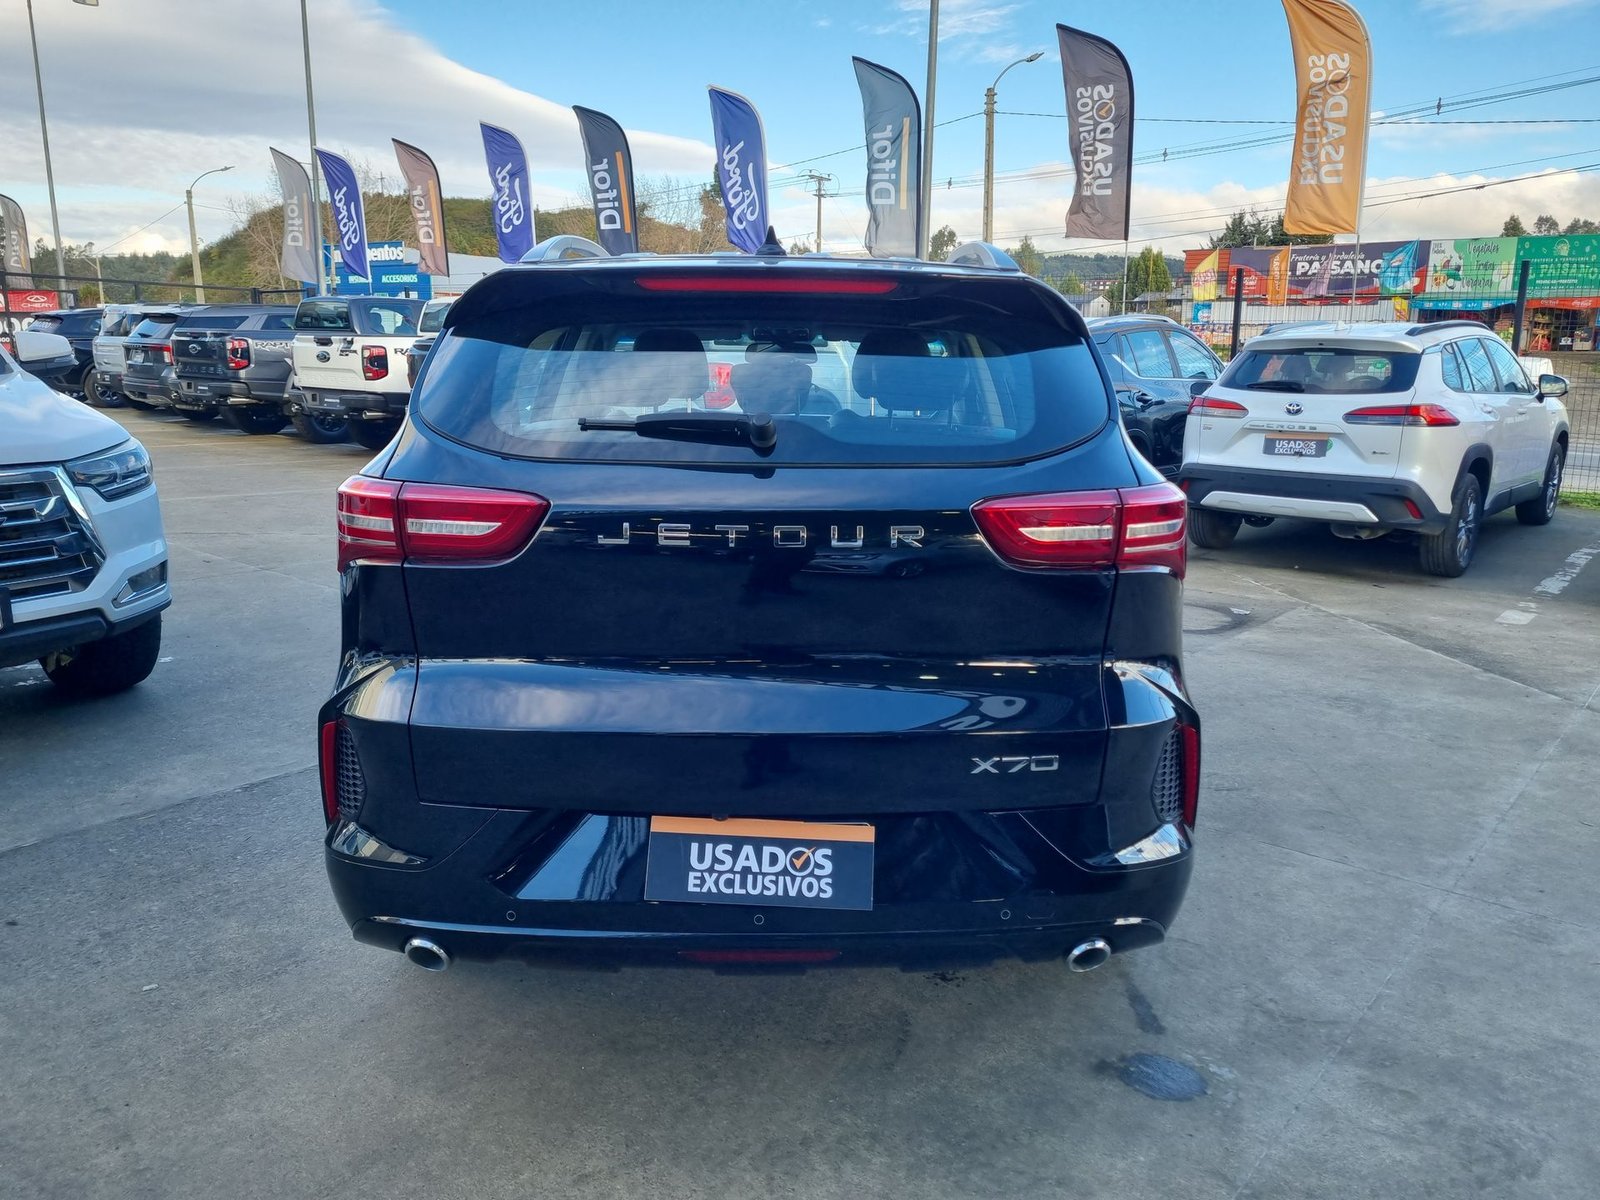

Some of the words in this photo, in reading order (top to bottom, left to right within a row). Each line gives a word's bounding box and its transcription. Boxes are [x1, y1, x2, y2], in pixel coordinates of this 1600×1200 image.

[1468, 242, 1499, 257] Vegetales
[1297, 259, 1384, 276] PASANO
[381, 274, 418, 283] ACCESORIOS
[1275, 440, 1316, 449] USADOS
[597, 522, 925, 548] JETOUR
[970, 754, 1060, 775] X70
[688, 842, 834, 877] USADOS
[687, 871, 833, 899] EXCLUSIVOS
